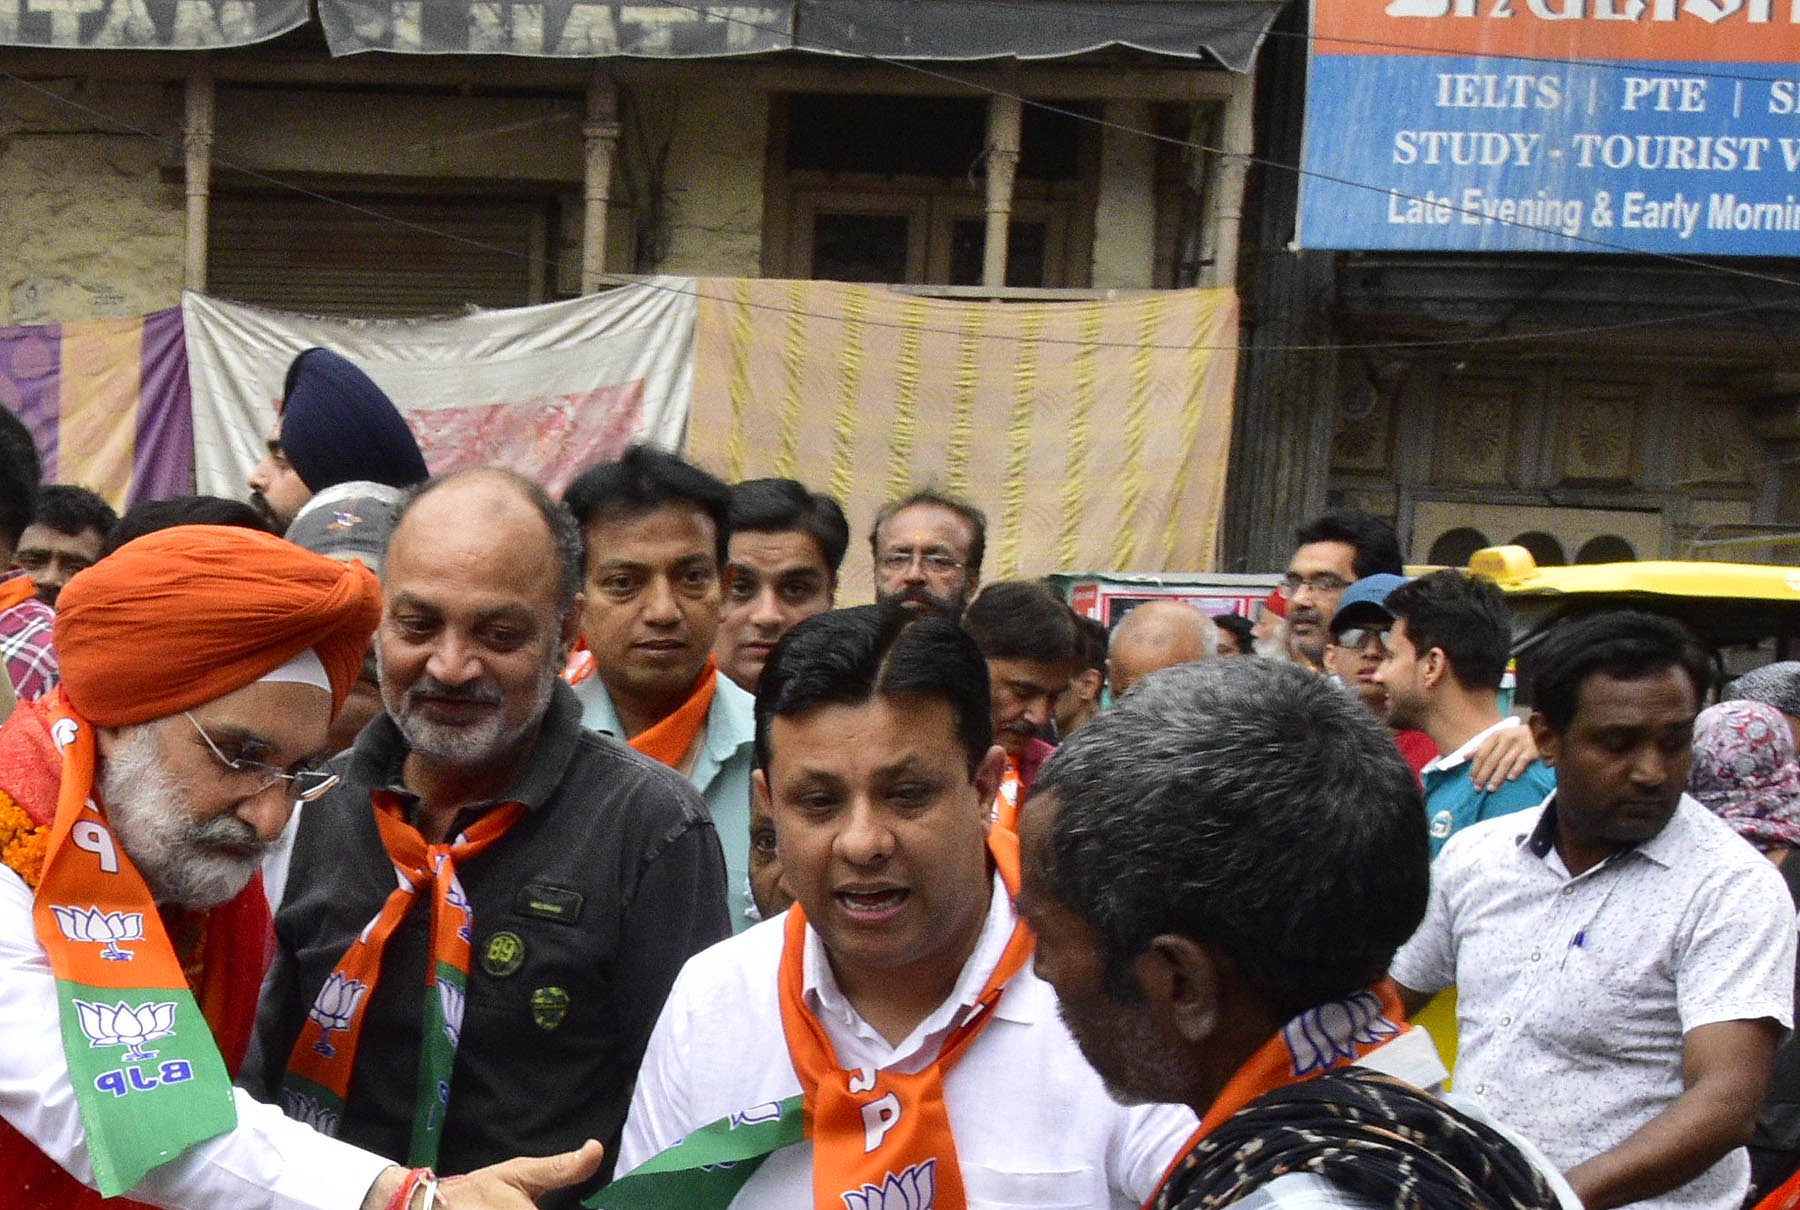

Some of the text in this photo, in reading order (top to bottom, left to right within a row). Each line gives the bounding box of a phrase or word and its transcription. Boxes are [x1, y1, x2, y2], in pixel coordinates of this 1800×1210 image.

[1435, 73, 1564, 110] IELTS
[1621, 78, 1707, 113] PTE
[1392, 132, 1540, 166] STUDY
[1571, 135, 1769, 172] TOURIST
[1388, 188, 1450, 225] Late
[1461, 189, 1583, 236] Evening
[1591, 194, 1613, 229] &
[1622, 193, 1700, 239] Early
